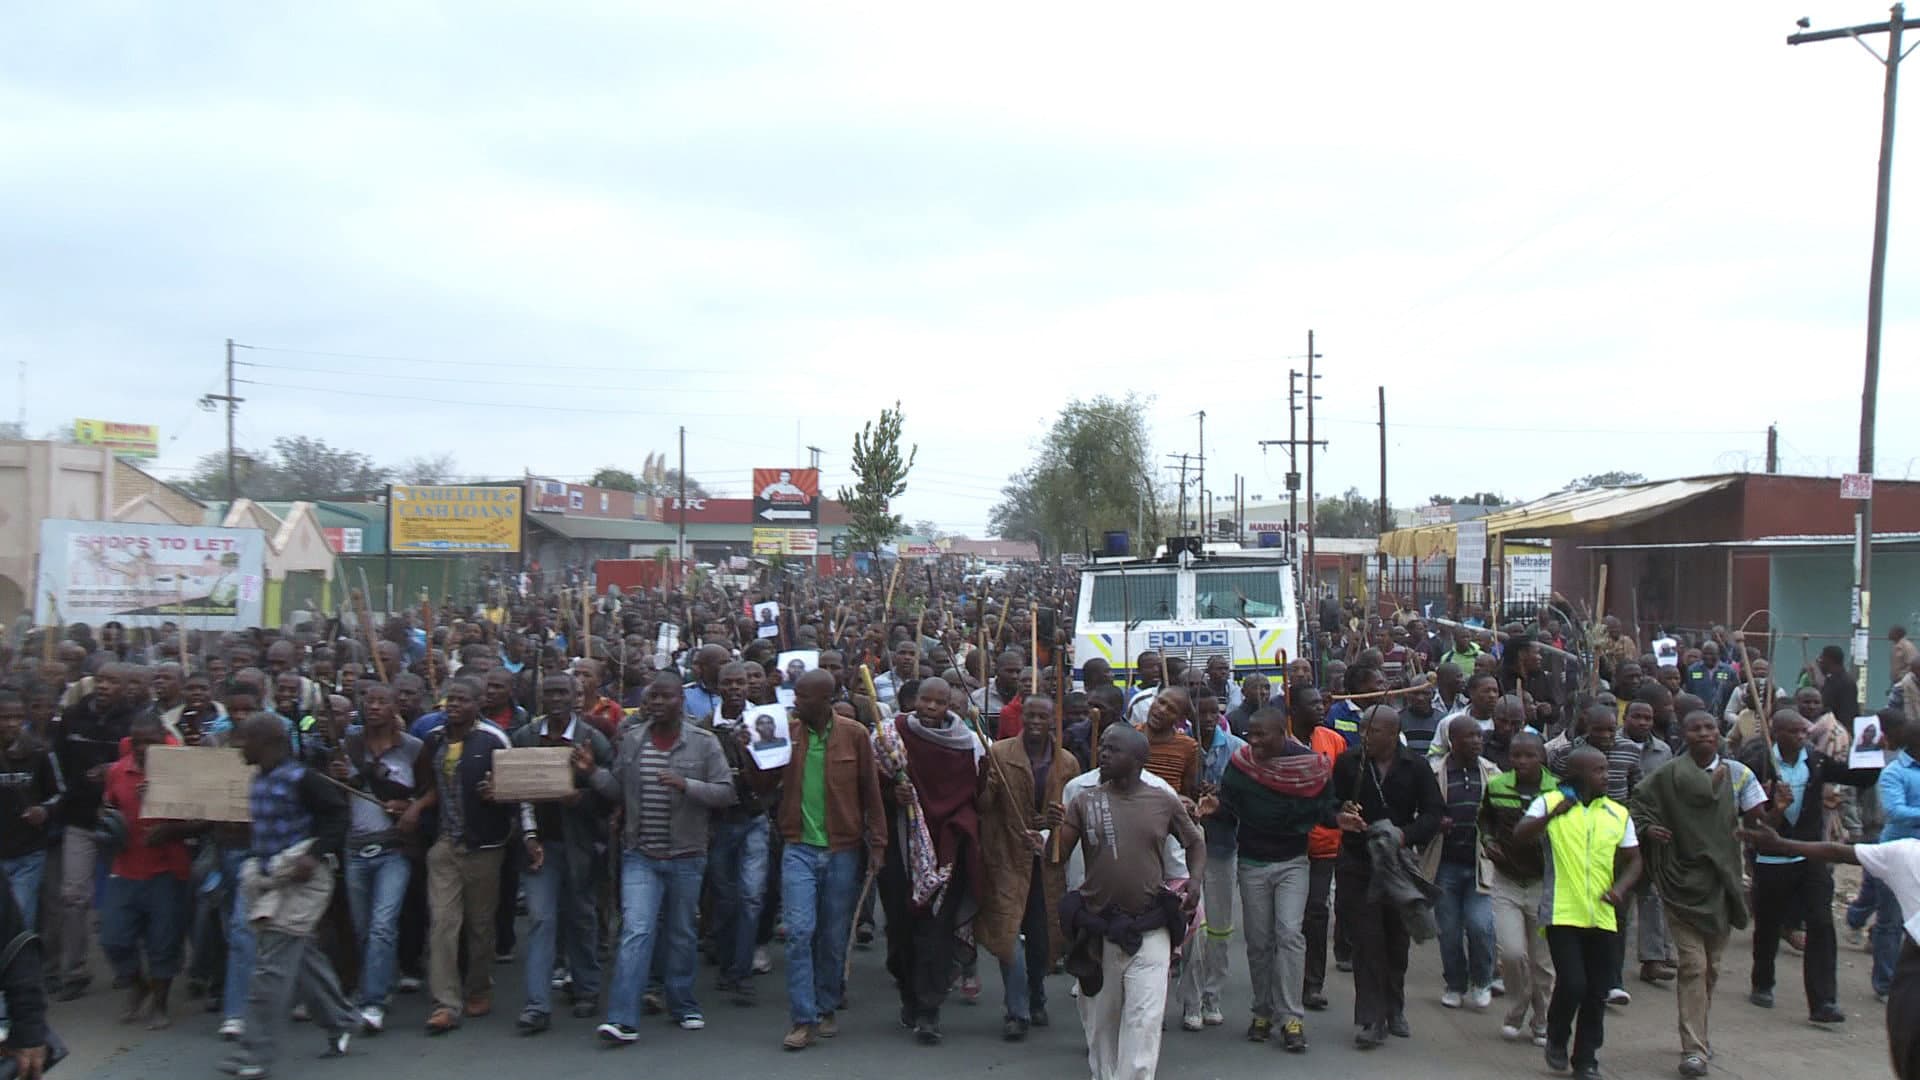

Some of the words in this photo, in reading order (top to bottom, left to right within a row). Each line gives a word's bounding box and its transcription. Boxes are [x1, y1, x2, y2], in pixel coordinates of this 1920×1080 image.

[399, 504, 449, 517] CASH
[453, 504, 513, 517] LOANS
[1249, 522, 1296, 532] MARIKA
[75, 535, 150, 550] SHOPS
[157, 537, 188, 550] TO
[194, 537, 235, 551] LET
